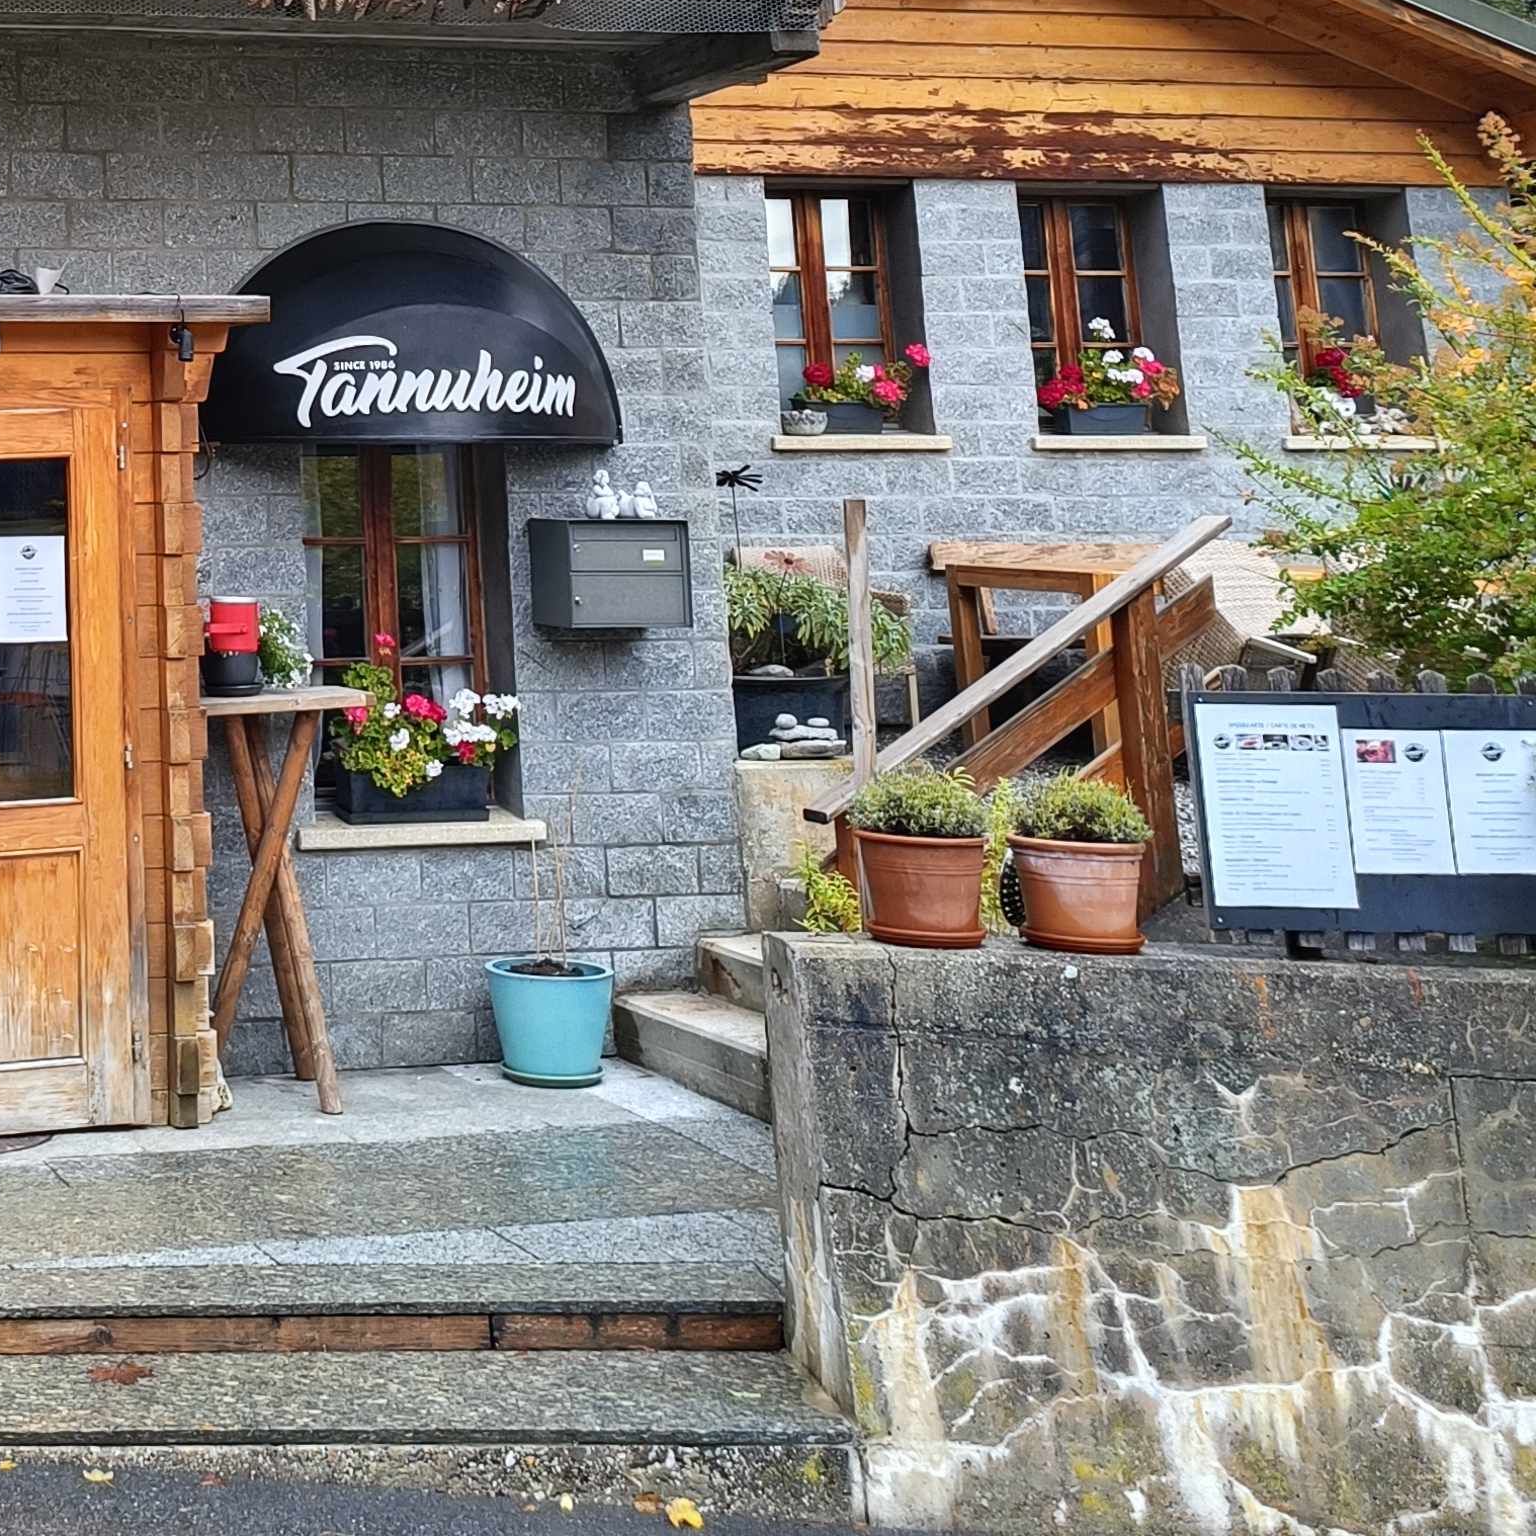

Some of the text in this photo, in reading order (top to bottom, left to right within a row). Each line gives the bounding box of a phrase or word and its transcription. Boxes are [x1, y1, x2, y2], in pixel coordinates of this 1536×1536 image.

[273, 335, 576, 428] Tannuheim
[333, 360, 396, 371] SINCE 1986
